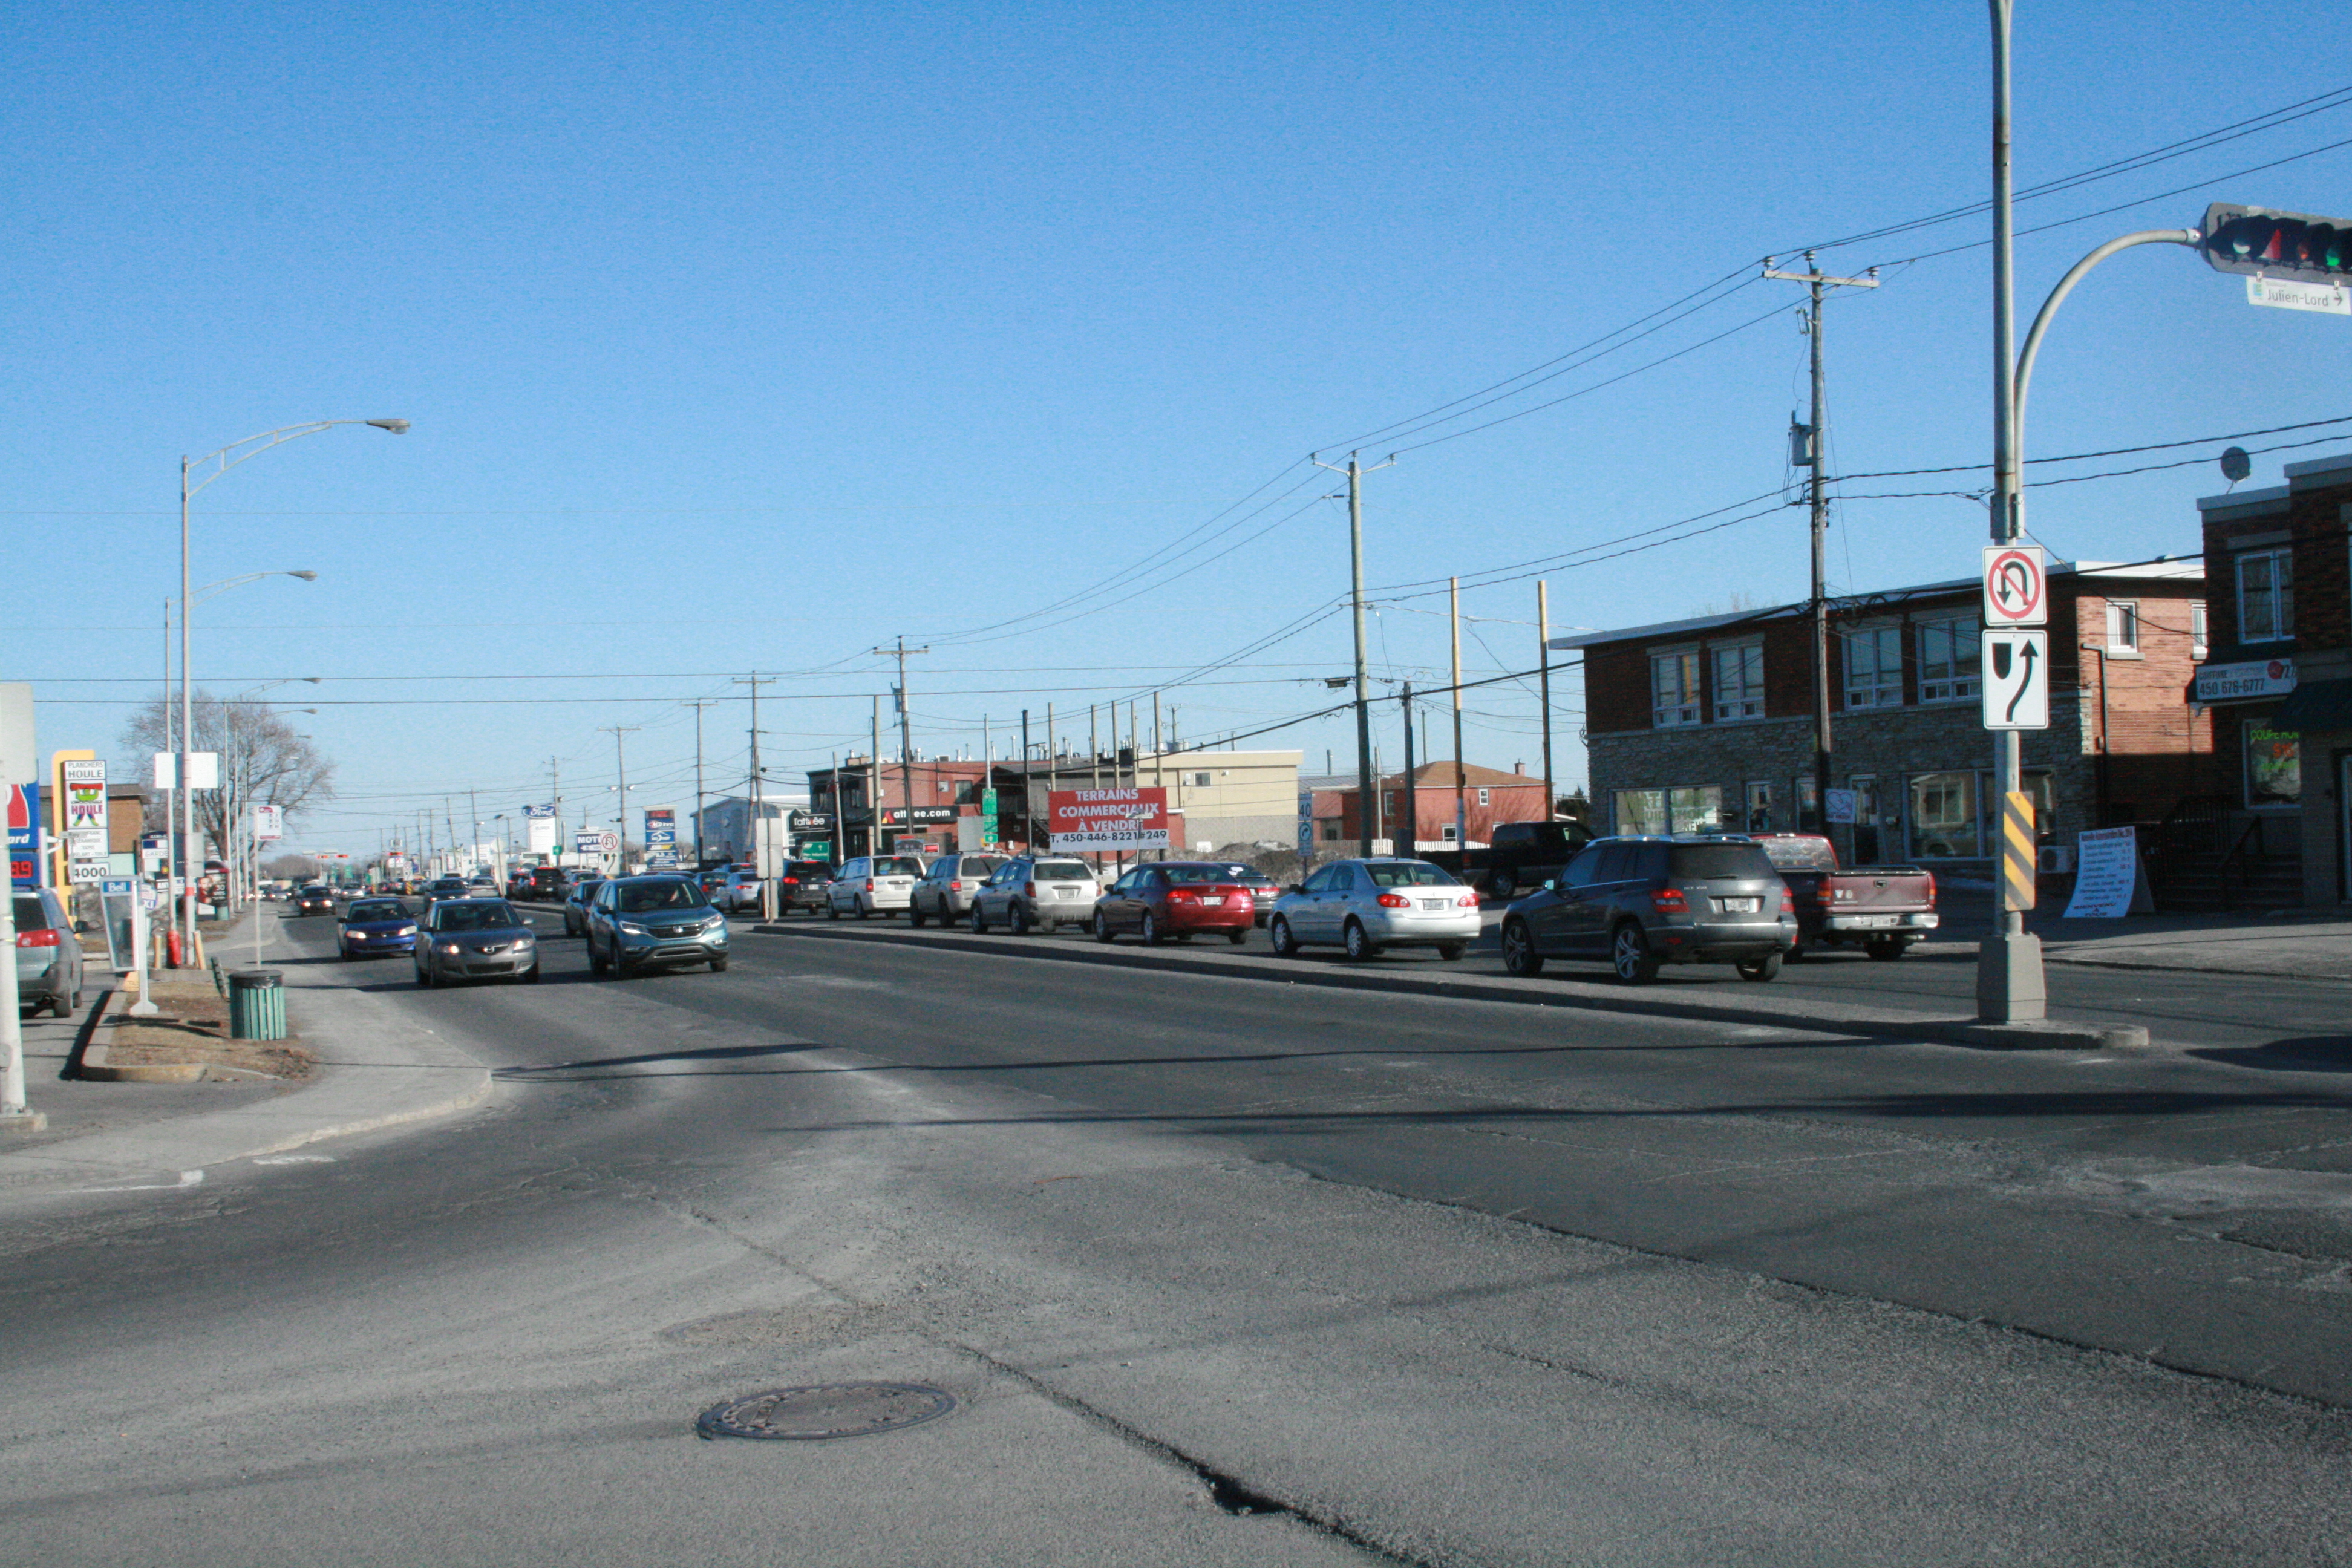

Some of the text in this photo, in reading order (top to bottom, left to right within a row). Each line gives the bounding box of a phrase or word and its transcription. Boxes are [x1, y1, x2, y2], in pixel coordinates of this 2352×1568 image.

[2268, 289, 2328, 307] Julien-Lord
[2200, 678, 2265, 696] 450 676-6777
[68, 769, 103, 779] HOULE
[1076, 788, 1139, 802] TERRAINS
[71, 804, 103, 815] HOULE
[530, 806, 555, 816] Ford
[1299, 803, 1311, 817] 40
[1077, 818, 1088, 832] À
[8, 834, 30, 844] ard
[1063, 831, 1138, 843] 450-446-8221
[74, 867, 107, 878] 4000
[109, 882, 126, 892] Bell
